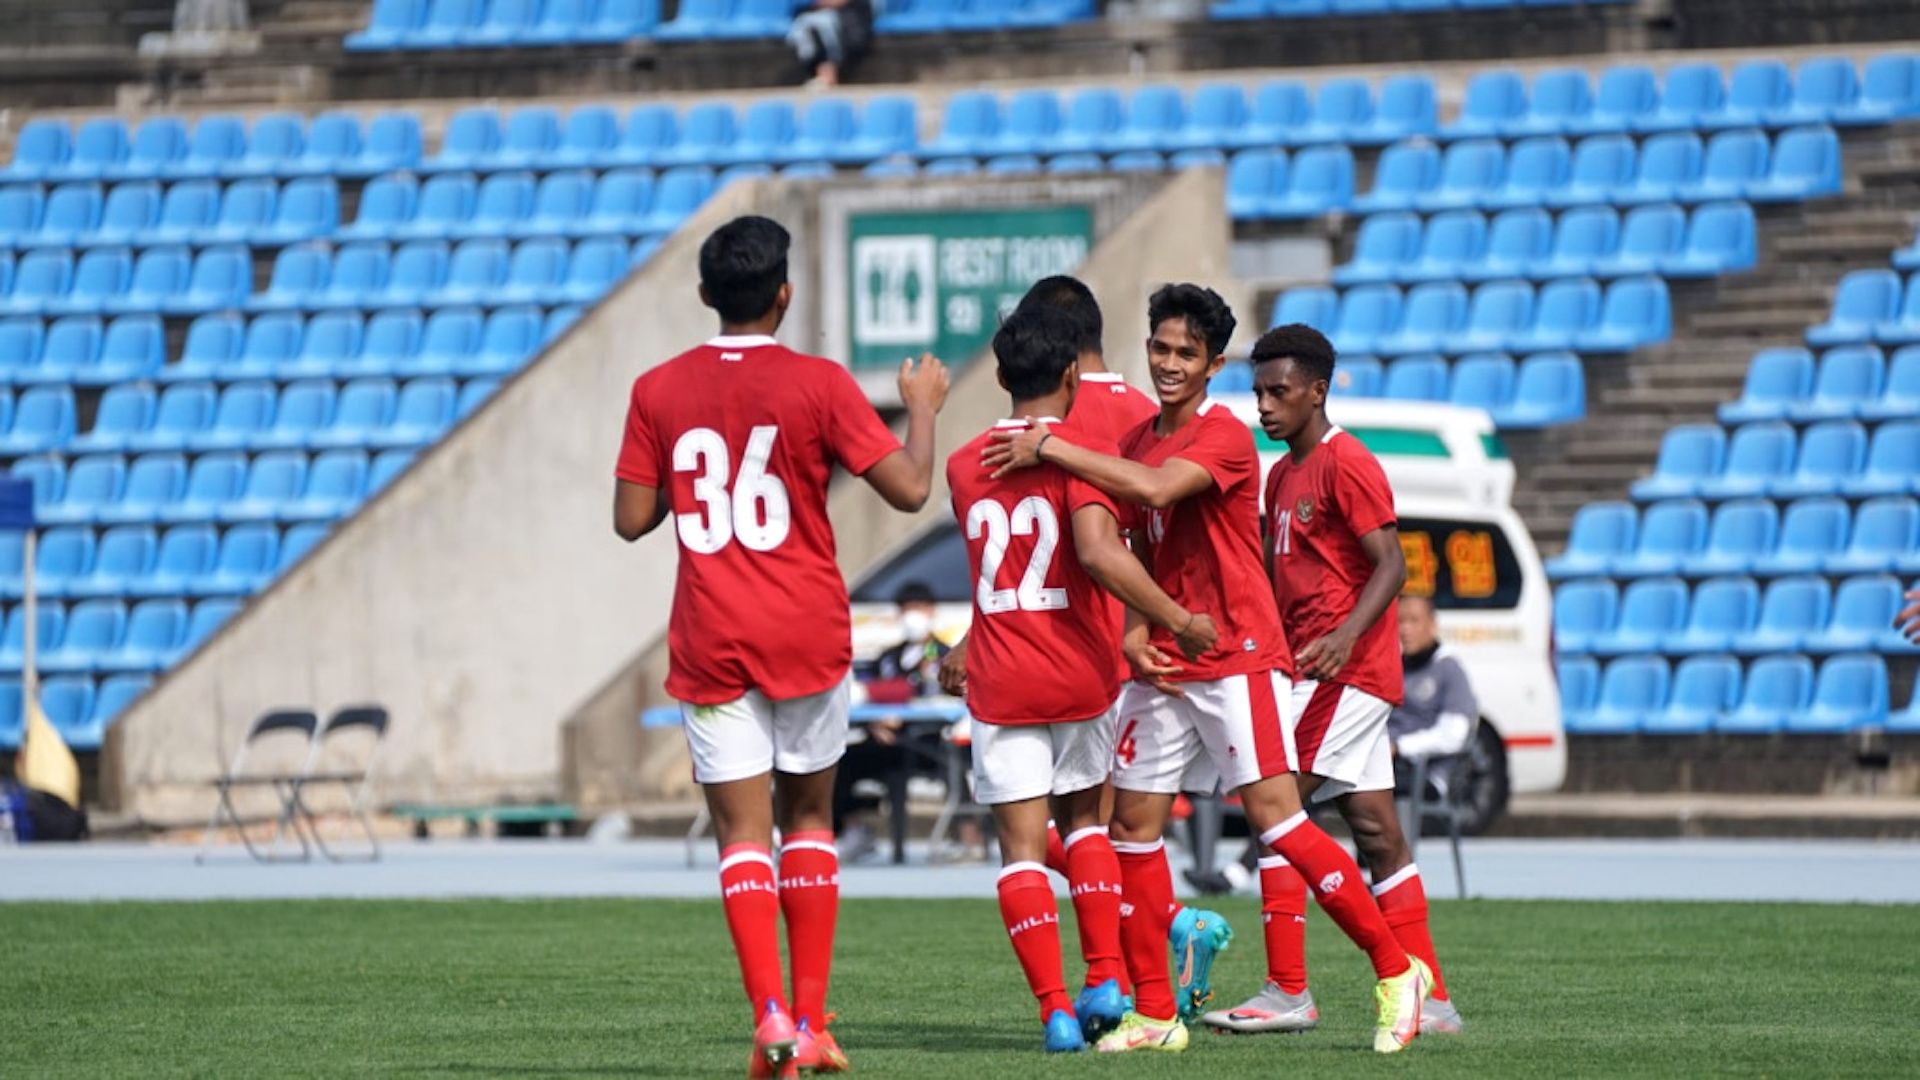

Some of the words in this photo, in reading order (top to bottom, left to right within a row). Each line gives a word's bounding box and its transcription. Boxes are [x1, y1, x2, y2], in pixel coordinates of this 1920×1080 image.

[940, 236, 1004, 287] REST
[672, 424, 791, 555] 36
[965, 495, 1069, 615] 22
